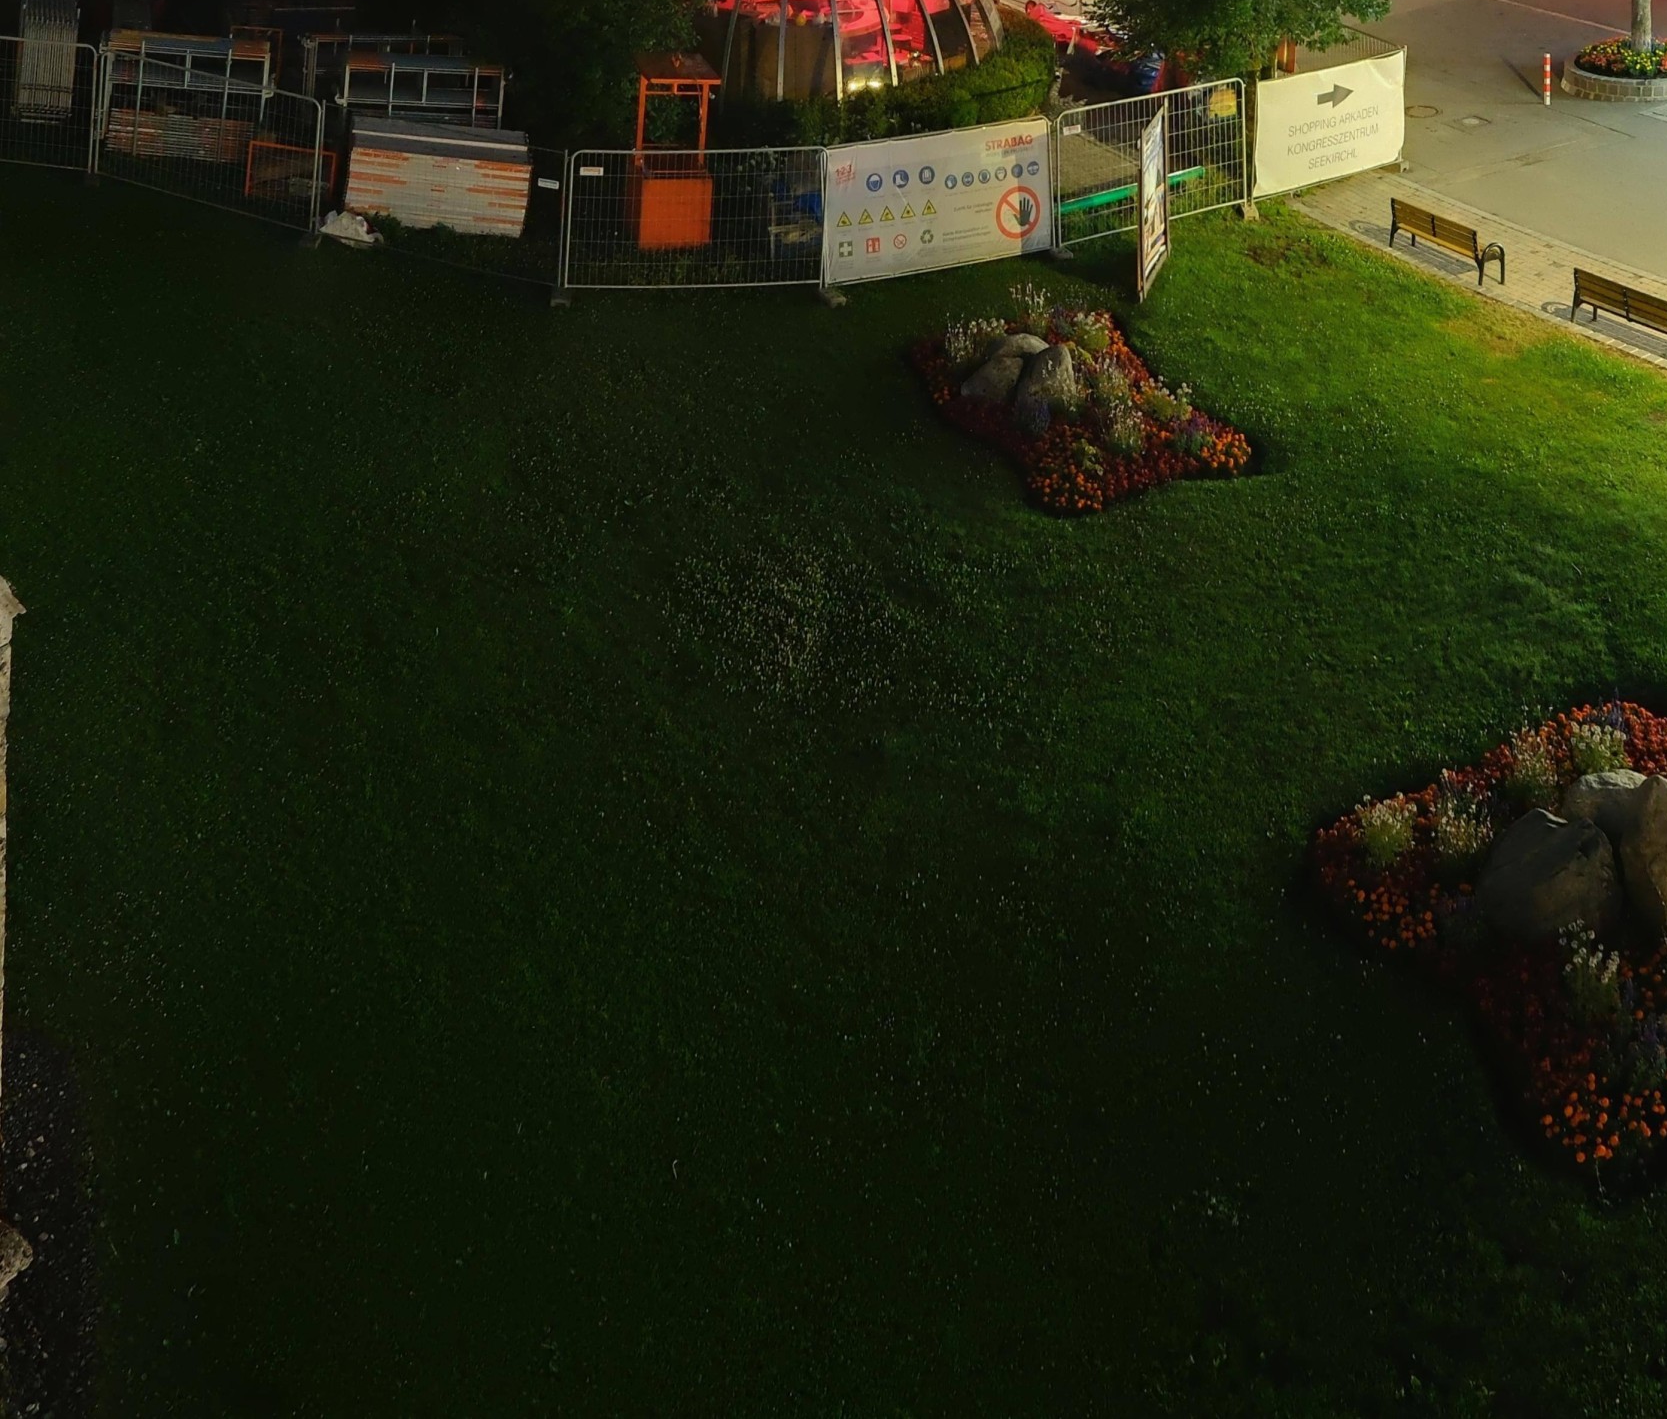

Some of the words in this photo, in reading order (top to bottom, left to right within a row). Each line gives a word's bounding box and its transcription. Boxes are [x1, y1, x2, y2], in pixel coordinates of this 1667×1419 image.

[1287, 116, 1337, 138] SHOPPING
[1339, 105, 1379, 125] ARKADEN
[985, 134, 1034, 152] STRABAG
[1287, 123, 1379, 157] KONGRESSZENTRUM
[1308, 148, 1358, 170] SEEKIRCHL
